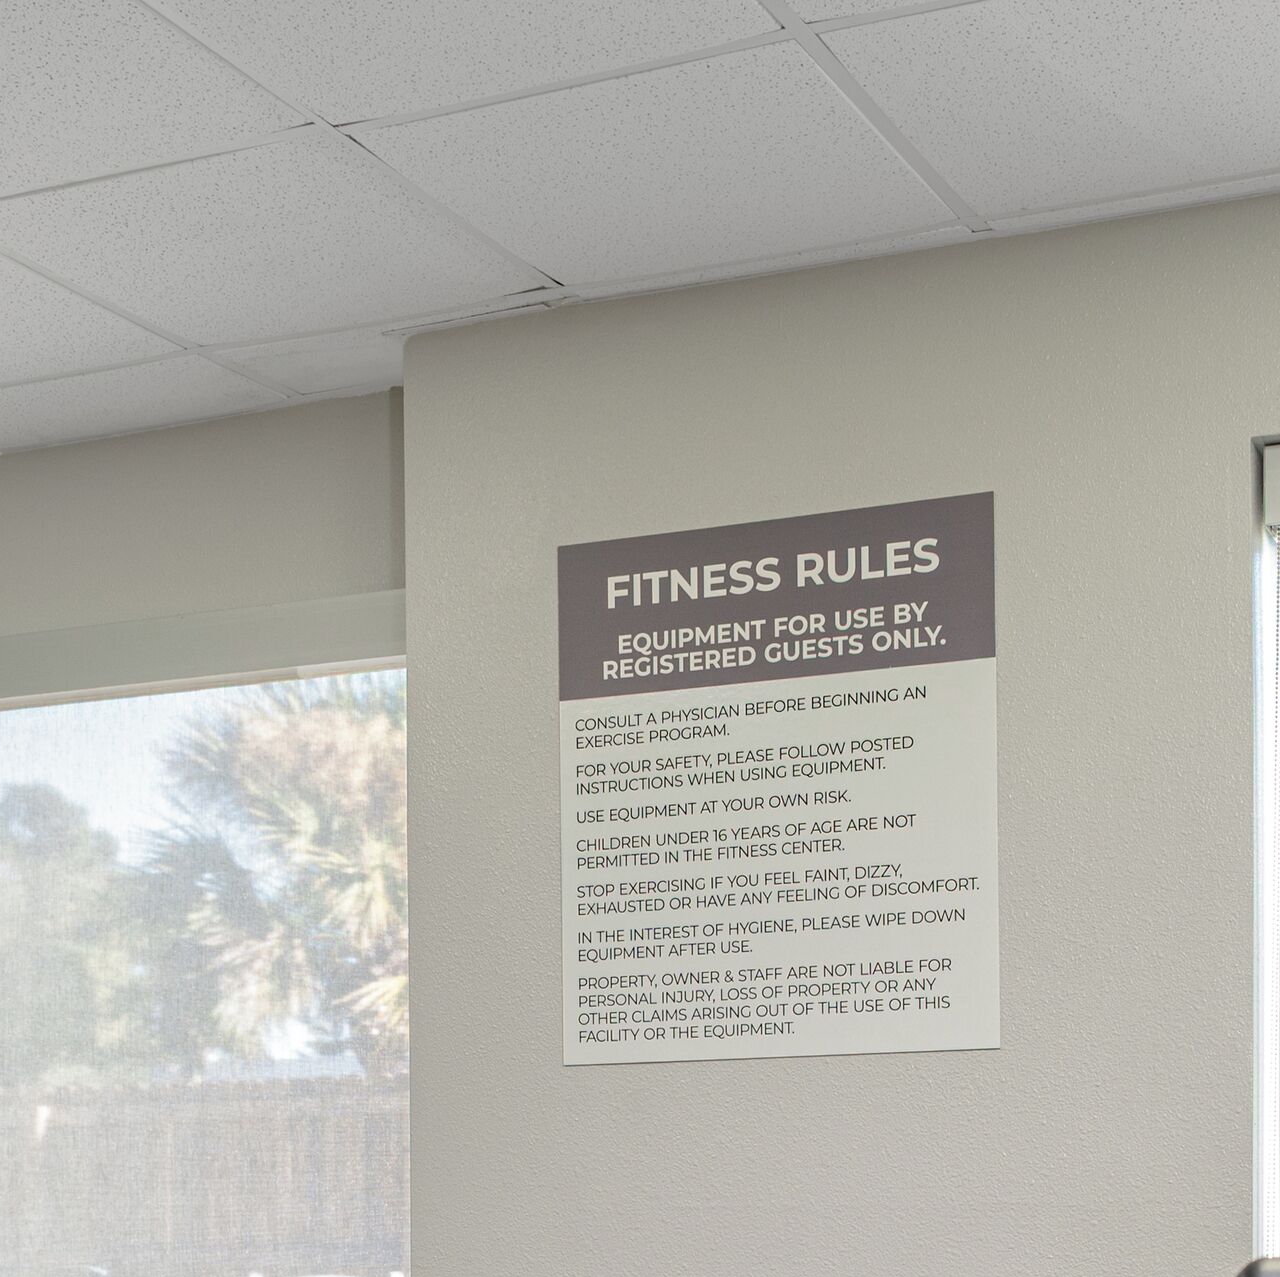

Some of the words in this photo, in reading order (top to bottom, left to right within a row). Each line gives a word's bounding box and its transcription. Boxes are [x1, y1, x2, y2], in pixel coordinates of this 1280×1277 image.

[606, 556, 781, 609] FITNESS
[796, 537, 940, 587] RULES
[617, 618, 766, 656] EQUIPMENT
[773, 612, 826, 637] FOR
[834, 605, 885, 631] USE
[893, 600, 928, 624] BY
[602, 645, 756, 680] REGISTERED
[763, 633, 864, 663] GUESTS
[871, 624, 946, 652] ONLY.
[574, 712, 643, 732] CONSULT
[645, 711, 657, 725] A
[660, 703, 739, 724] PHYSICIAN
[744, 696, 806, 716] BEFORE
[810, 687, 899, 710] BEGINNING
[902, 684, 926, 701] AN
[575, 730, 644, 749] EXERCISE
[648, 722, 730, 743] PROGRAM.
[575, 762, 606, 778] FOR
[609, 758, 651, 775] YOUR
[654, 753, 712, 771] SAFETY,
[716, 747, 774, 766] PLEASE
[778, 741, 846, 760] FOLLOW
[850, 734, 914, 754] POSTED
[575, 773, 684, 795] INSTRUCTIONS
[686, 769, 735, 786] WHEN
[739, 764, 787, 782] USING
[791, 755, 886, 778] EQUIPMENT.
[575, 808, 605, 824] USE
[609, 801, 697, 823] EQUIPMENT
[699, 799, 718, 814] AT
[720, 795, 764, 812] YOUR
[768, 792, 808, 809] OWN
[813, 788, 851, 805] RISK.
[575, 833, 651, 852] CHILDREN
[655, 829, 709, 846] UNDER
[711, 827, 727, 842] 16
[730, 823, 781, 840] YEARS
[783, 821, 807, 837] OF
[809, 818, 842, 835] AGE
[845, 815, 878, 832] ARE
[882, 812, 917, 829] NOT
[576, 851, 660, 870] PERMITTED
[664, 849, 679, 864] IN
[682, 847, 713, 862] THE
[717, 842, 777, 860] FITNESS
[780, 837, 845, 855] CENTER.
[576, 882, 615, 899] STOP
[618, 876, 705, 896] EXERCISING
[710, 875, 723, 889] IF
[726, 872, 759, 888] YOU
[764, 870, 801, 886] FEEL
[804, 866, 850, 883] FAINT,
[854, 863, 902, 880] DIZZY,
[577, 897, 665, 916] EXHAUSTED
[668, 895, 691, 910] OR
[695, 892, 736, 909] HAVE
[739, 890, 772, 906] ANY
[776, 885, 840, 903] FEELING
[843, 883, 867, 899] OF
[871, 876, 980, 897] DISCOMFORT.
[577, 930, 592, 944] IN
[595, 928, 625, 943] THE
[629, 923, 699, 941] INTEREST
[701, 922, 724, 937] OF
[728, 918, 797, 935] HYGIENE,
[801, 913, 860, 931] PLEASE
[864, 911, 906, 927] WIPE
[911, 907, 965, 924] DOWN
[577, 944, 665, 963] EQUIPMENT
[667, 941, 716, 957] AFTER
[720, 939, 753, 954] USE.
[577, 973, 657, 990] PROPERTY,
[661, 970, 720, 986] OWNER
[723, 969, 734, 983] &
[737, 966, 783, 982] STAFF
[785, 964, 818, 979] ARE
[822, 962, 856, 978] NOT
[859, 959, 914, 976] LIABLE
[918, 957, 952, 973] FOR
[577, 991, 657, 1008] PERSONAL
[661, 988, 715, 1004] INJURY,
[719, 986, 757, 1001] LOSS
[760, 984, 783, 999] OF
[787, 980, 871, 998] PROPERTY
[873, 979, 898, 993] OR
[901, 976, 936, 992] ANY
[577, 1010, 627, 1026] OTHER
[631, 1007, 687, 1023] CLAIMS
[690, 1004, 751, 1021] ARISING
[755, 1002, 788, 1017] OUT
[791, 1001, 814, 1016] OF
[817, 999, 848, 1015] THE
[853, 998, 884, 1013] USE
[887, 996, 911, 1011] OF
[913, 994, 951, 1010] THIS
[578, 1027, 640, 1043] FACILITY
[642, 1026, 666, 1040] OR
[668, 1024, 699, 1039] THE
[703, 1020, 795, 1039] EQUIPMENT.
